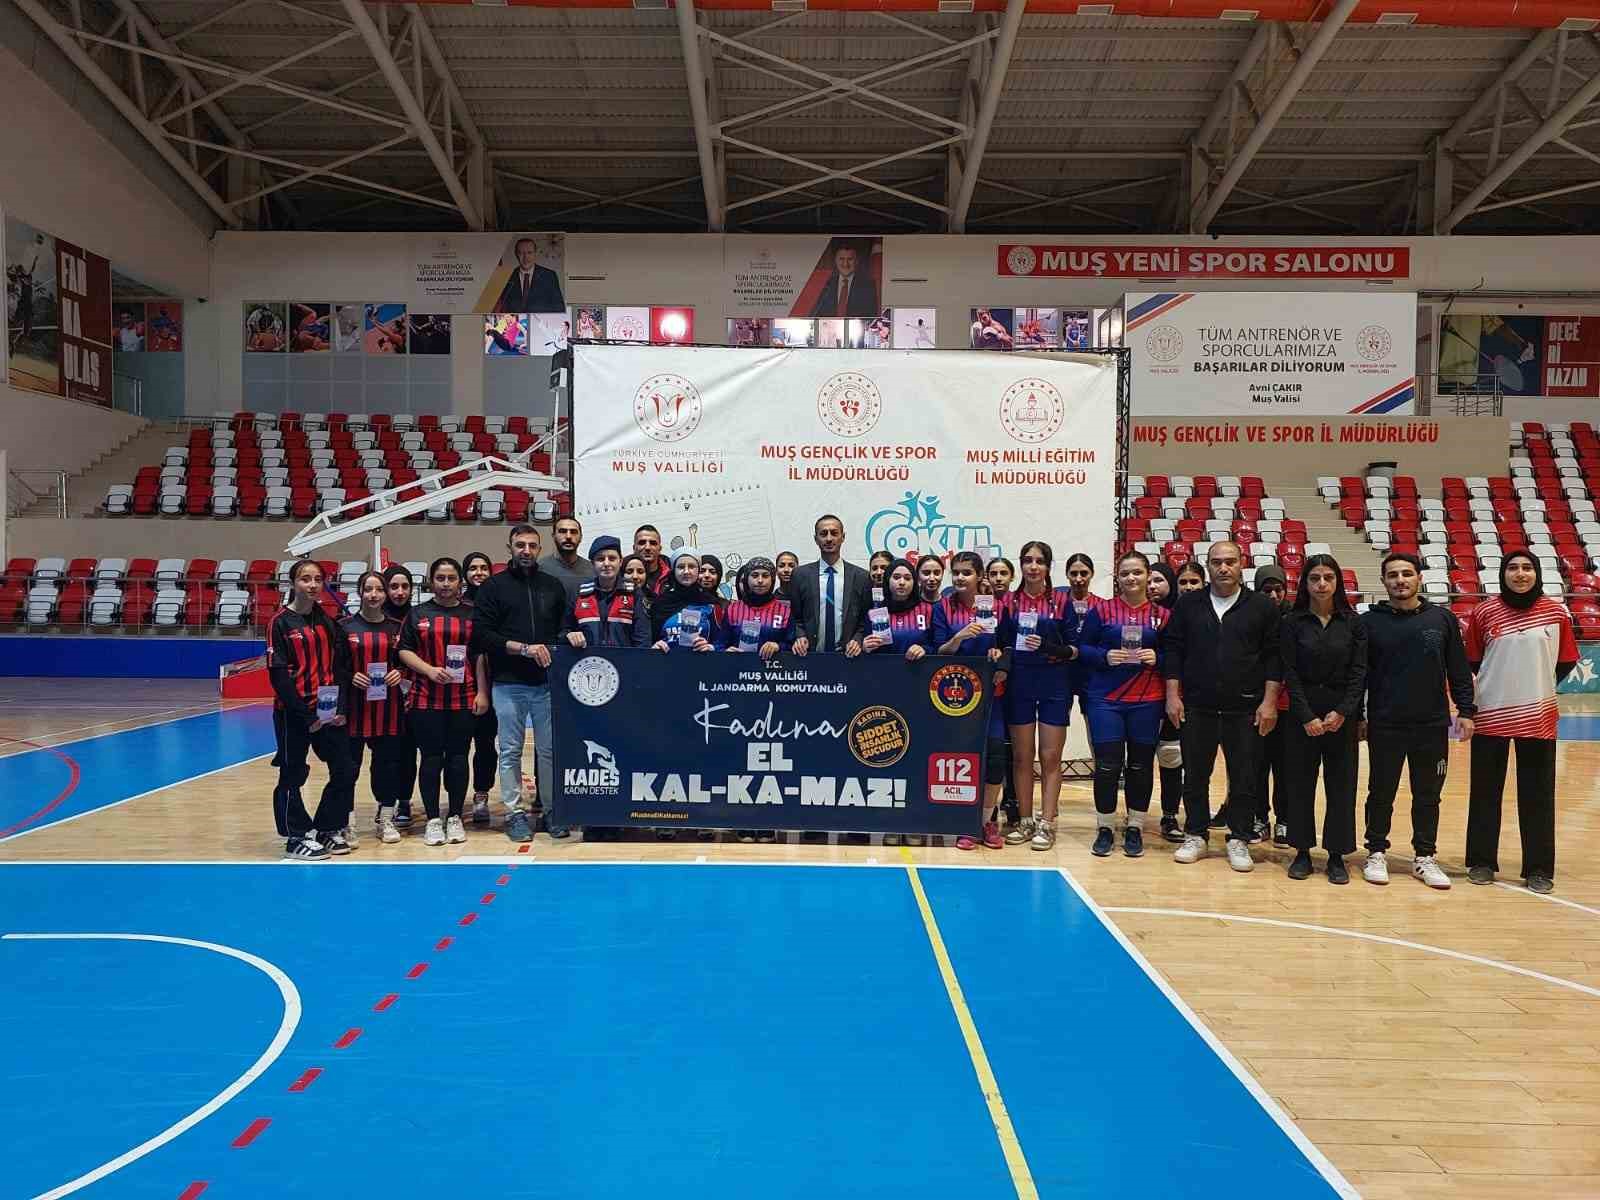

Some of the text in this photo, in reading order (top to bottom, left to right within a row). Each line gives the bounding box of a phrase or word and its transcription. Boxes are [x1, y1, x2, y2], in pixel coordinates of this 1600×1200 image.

[1041, 247, 1394, 275] MUŞ YENİ SPOR SALONU
[1197, 325, 1343, 341] TÜM ANTRENÖR VE
[1200, 344, 1337, 357] SPORCULARIMIZA
[1194, 362, 1267, 375] BAŞARILAR
[1271, 360, 1345, 372] DİLİYORUM
[1249, 383, 1303, 393] Avni ÇAKIR
[1251, 394, 1300, 404] Muş Valisi
[1134, 423, 1438, 447] MUŞ GENÇLİK VE SPOR İL MÜDÜRLÜĞÜ
[761, 444, 937, 461] MUŞ GENÇLİK VE SPOR
[966, 447, 1095, 465] MUŞ MİLLİ EĞİTİM
[612, 462, 724, 475] MUŞ VALİLİĞİ
[788, 466, 910, 481] İL MÜDÜRLÜĞÜ
[975, 469, 1087, 484] İL MÜDÜRLÜĞÜ
[773, 614, 783, 629] 2
[916, 614, 926, 631] 9
[765, 660, 783, 669] T.C.
[738, 670, 808, 682] MUŞ VALİLİĞİ
[698, 681, 848, 694] İL JANDARMA KOMUTANLIĞI
[693, 697, 848, 745] Kadına
[747, 742, 793, 771] EL
[936, 758, 972, 782] 112
[563, 786, 619, 795] KADIN DESTEK
[631, 772, 907, 808] KAL-KA-MAZ!
